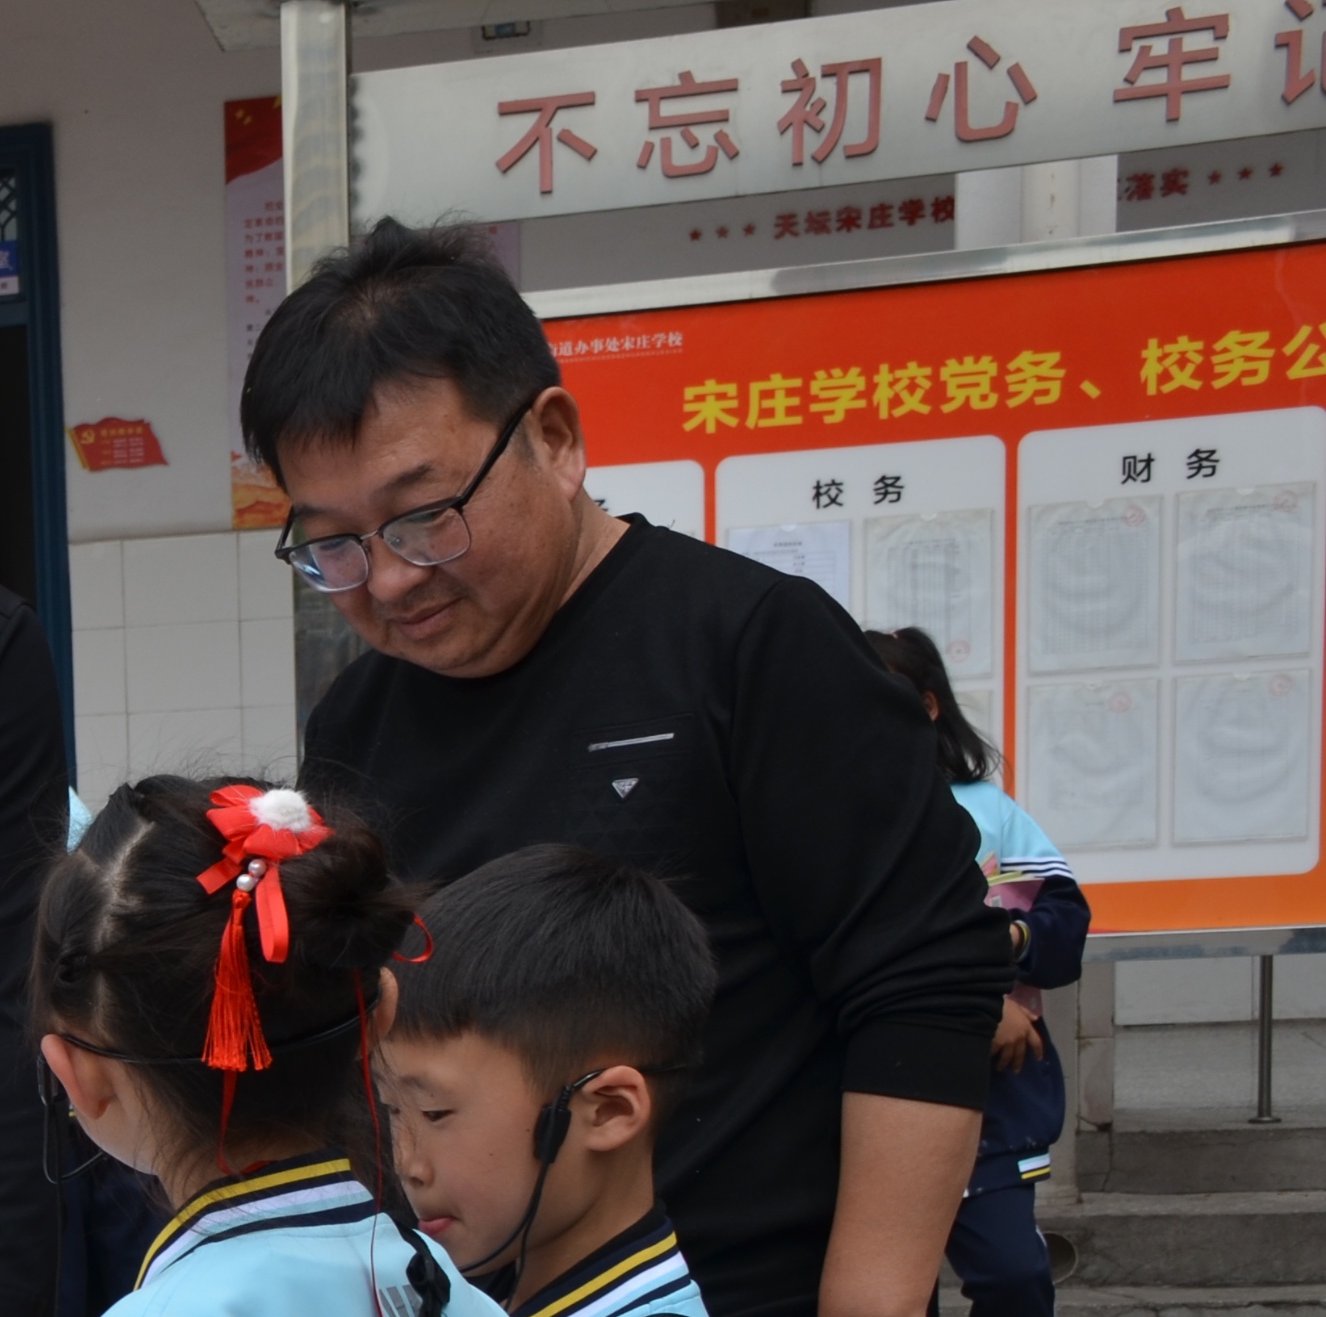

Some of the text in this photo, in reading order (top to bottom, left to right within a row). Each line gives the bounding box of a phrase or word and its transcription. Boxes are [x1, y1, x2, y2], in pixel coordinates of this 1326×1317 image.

[496, 34, 1038, 195] 不忘初心
[1116, 166, 1190, 203] 落实
[1121, 448, 1221, 484] 财务
[812, 474, 906, 509] 校务
